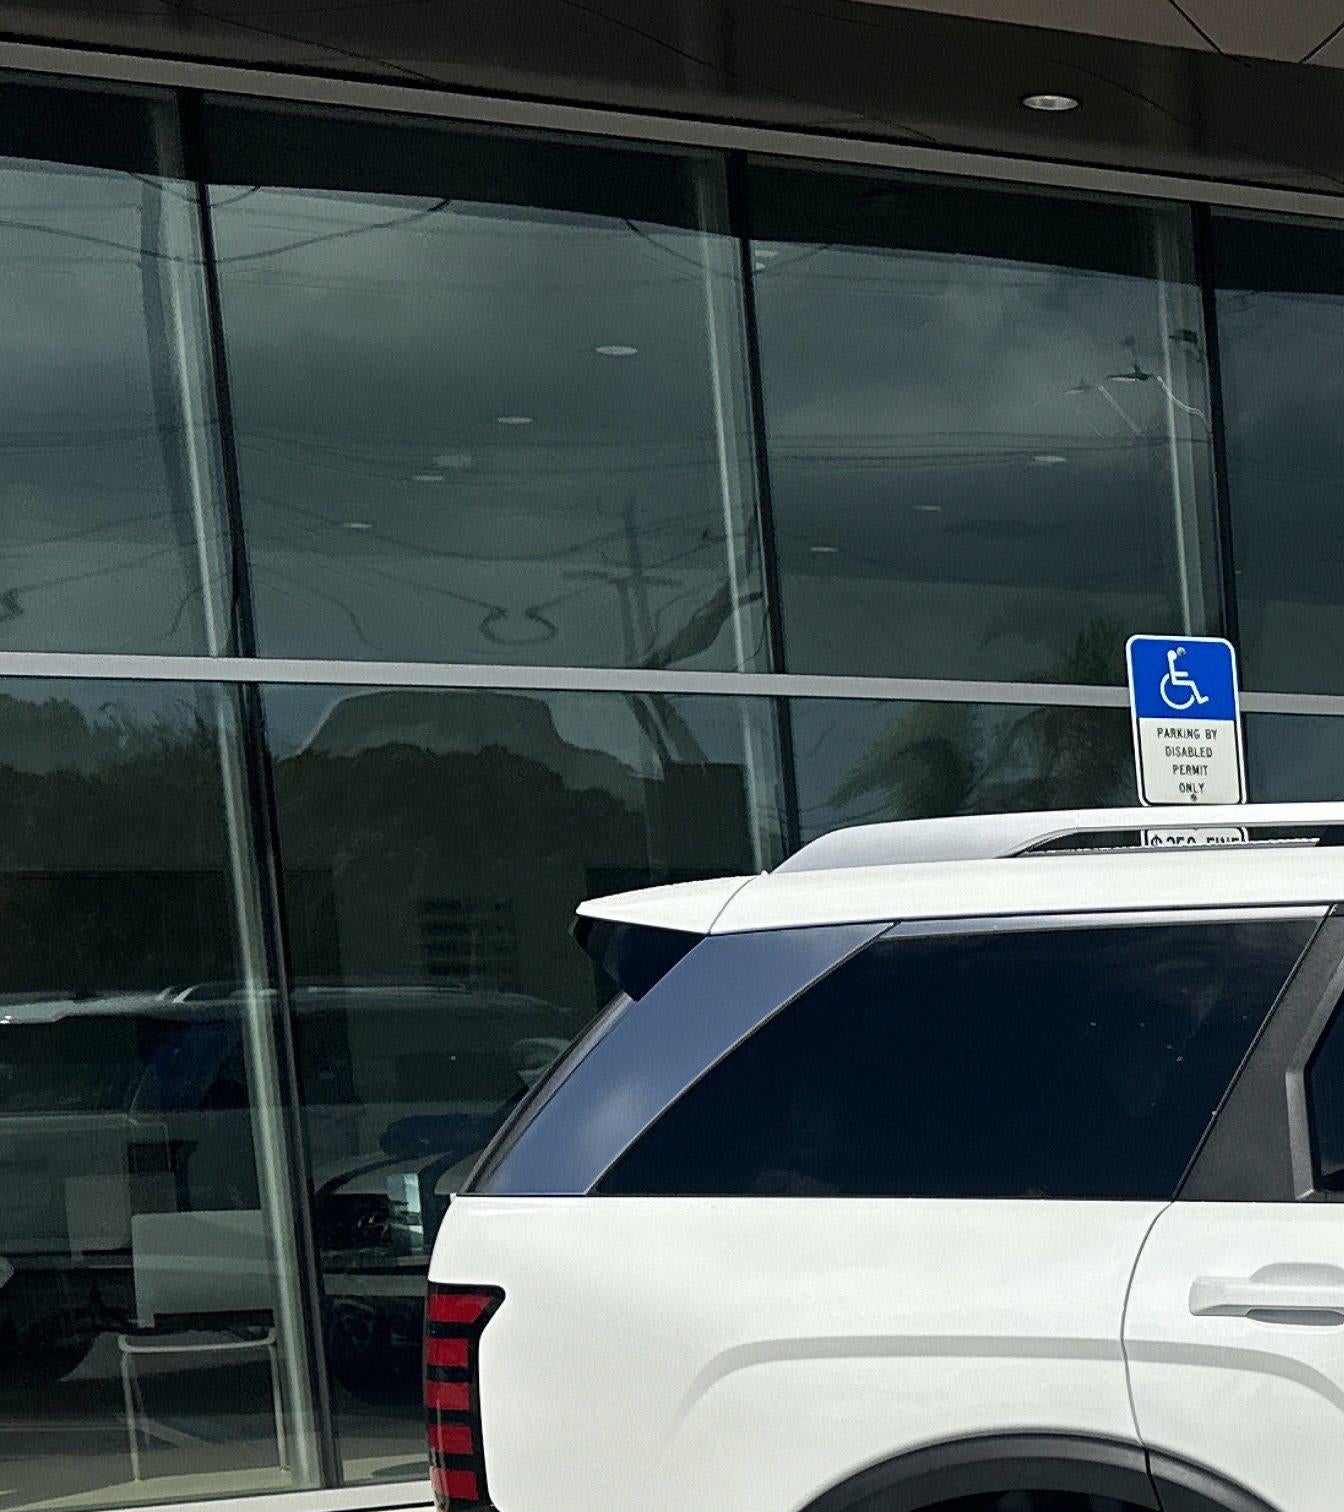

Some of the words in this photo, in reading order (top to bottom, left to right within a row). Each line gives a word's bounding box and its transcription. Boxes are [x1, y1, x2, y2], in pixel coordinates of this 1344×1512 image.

[1157, 727, 1201, 740] PARKING
[1205, 728, 1218, 740] BY
[1165, 745, 1213, 758] DISABLED
[1172, 764, 1208, 776] PERMIT
[1179, 782, 1204, 794] ONLY
